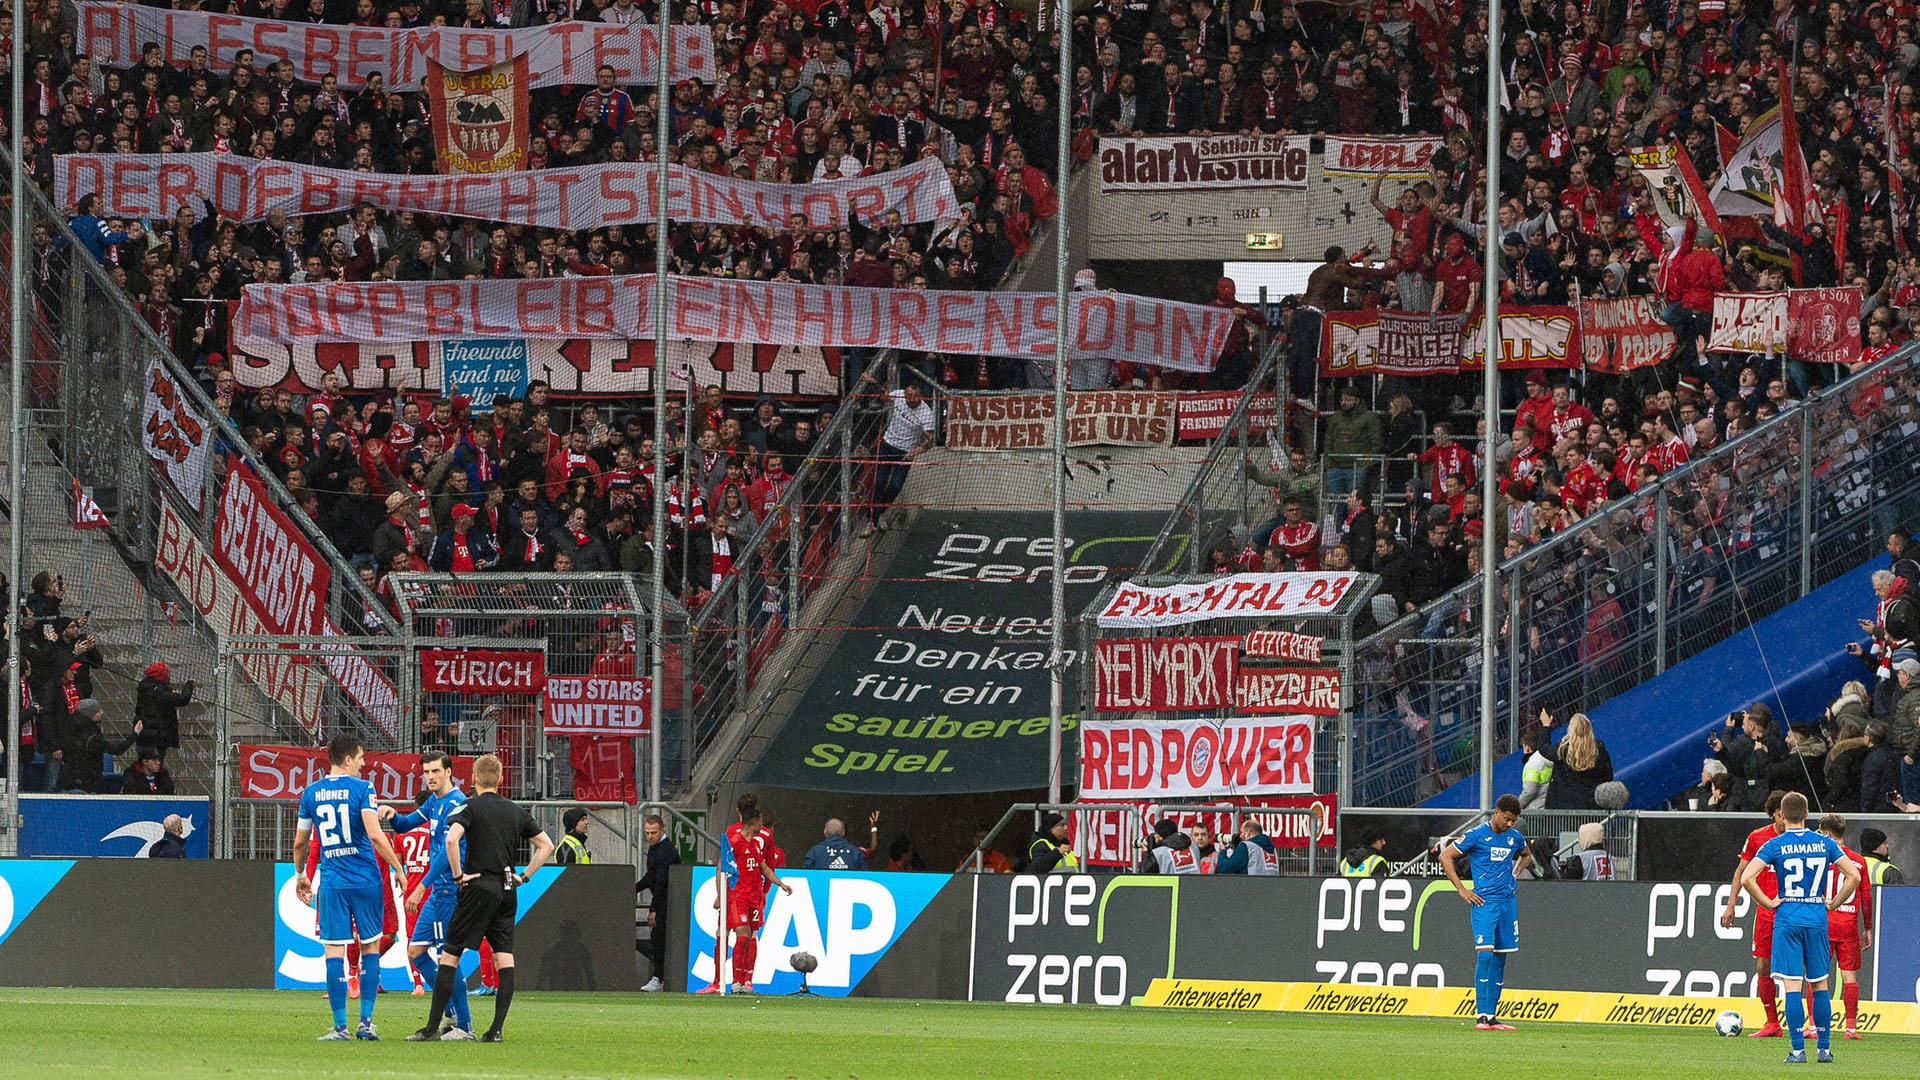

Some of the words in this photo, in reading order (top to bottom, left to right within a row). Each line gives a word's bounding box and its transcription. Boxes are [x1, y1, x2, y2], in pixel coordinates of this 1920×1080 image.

[84, 5, 287, 66] ALLES
[302, 27, 440, 84] BEIM
[460, 25, 704, 82] ALTEN:
[441, 146, 523, 173] MÜNCHEN
[1200, 138, 1259, 155] Sektion
[1340, 143, 1433, 169] REBELS
[67, 157, 200, 215] DER
[215, 161, 341, 219] DFB
[600, 171, 742, 223] SEIN
[243, 284, 405, 337] HOPP
[427, 276, 658, 334] BLEIBT
[677, 278, 773, 341] EIN
[795, 287, 1231, 367] HURENSOHN!
[445, 340, 524, 361] Freunde
[1380, 333, 1460, 358] JUNGS!
[1622, 331, 1676, 366] PRIDE
[450, 364, 492, 383] sind
[494, 363, 521, 382] nie
[1179, 399, 1225, 412] FREIHEIT
[951, 422, 1045, 449] IMMER
[1106, 418, 1168, 444] UNS
[938, 533, 1074, 556] pre
[159, 509, 217, 616] BAD
[925, 559, 1108, 583] zero
[1298, 576, 1351, 609] 93
[1245, 630, 1289, 659] LETZTE
[1289, 633, 1324, 662] REIHE
[434, 654, 532, 687] ZÜRICH
[1094, 639, 1239, 708] NEUMARKT
[548, 679, 582, 700] RED
[586, 679, 644, 701] STARS
[852, 674, 932, 702] für
[941, 681, 1023, 705] ein
[1236, 672, 1340, 710] HARZBURG
[551, 703, 644, 727] UNITED
[825, 713, 1080, 739] sauberes
[582, 742, 621, 783] 19
[804, 743, 955, 775] Spiel.
[1080, 727, 1155, 790] RED
[1160, 723, 1313, 789] POWER
[315, 788, 349, 801] HÜBNER
[576, 783, 636, 800] DAVIES
[316, 803, 352, 847] 21
[403, 836, 430, 867] 24
[1491, 849, 1508, 859] SAP
[1781, 840, 1827, 856] KRAMARIĆ
[1783, 857, 1827, 897] 27
[1007, 874, 1097, 944] pre
[1316, 878, 1413, 949] pre
[1647, 883, 1751, 957] pre
[1004, 955, 1127, 1006] zero
[1163, 980, 1262, 1010] interwetten
[1304, 984, 1409, 1015] interwetten
[1605, 995, 1716, 1028] interwetten
